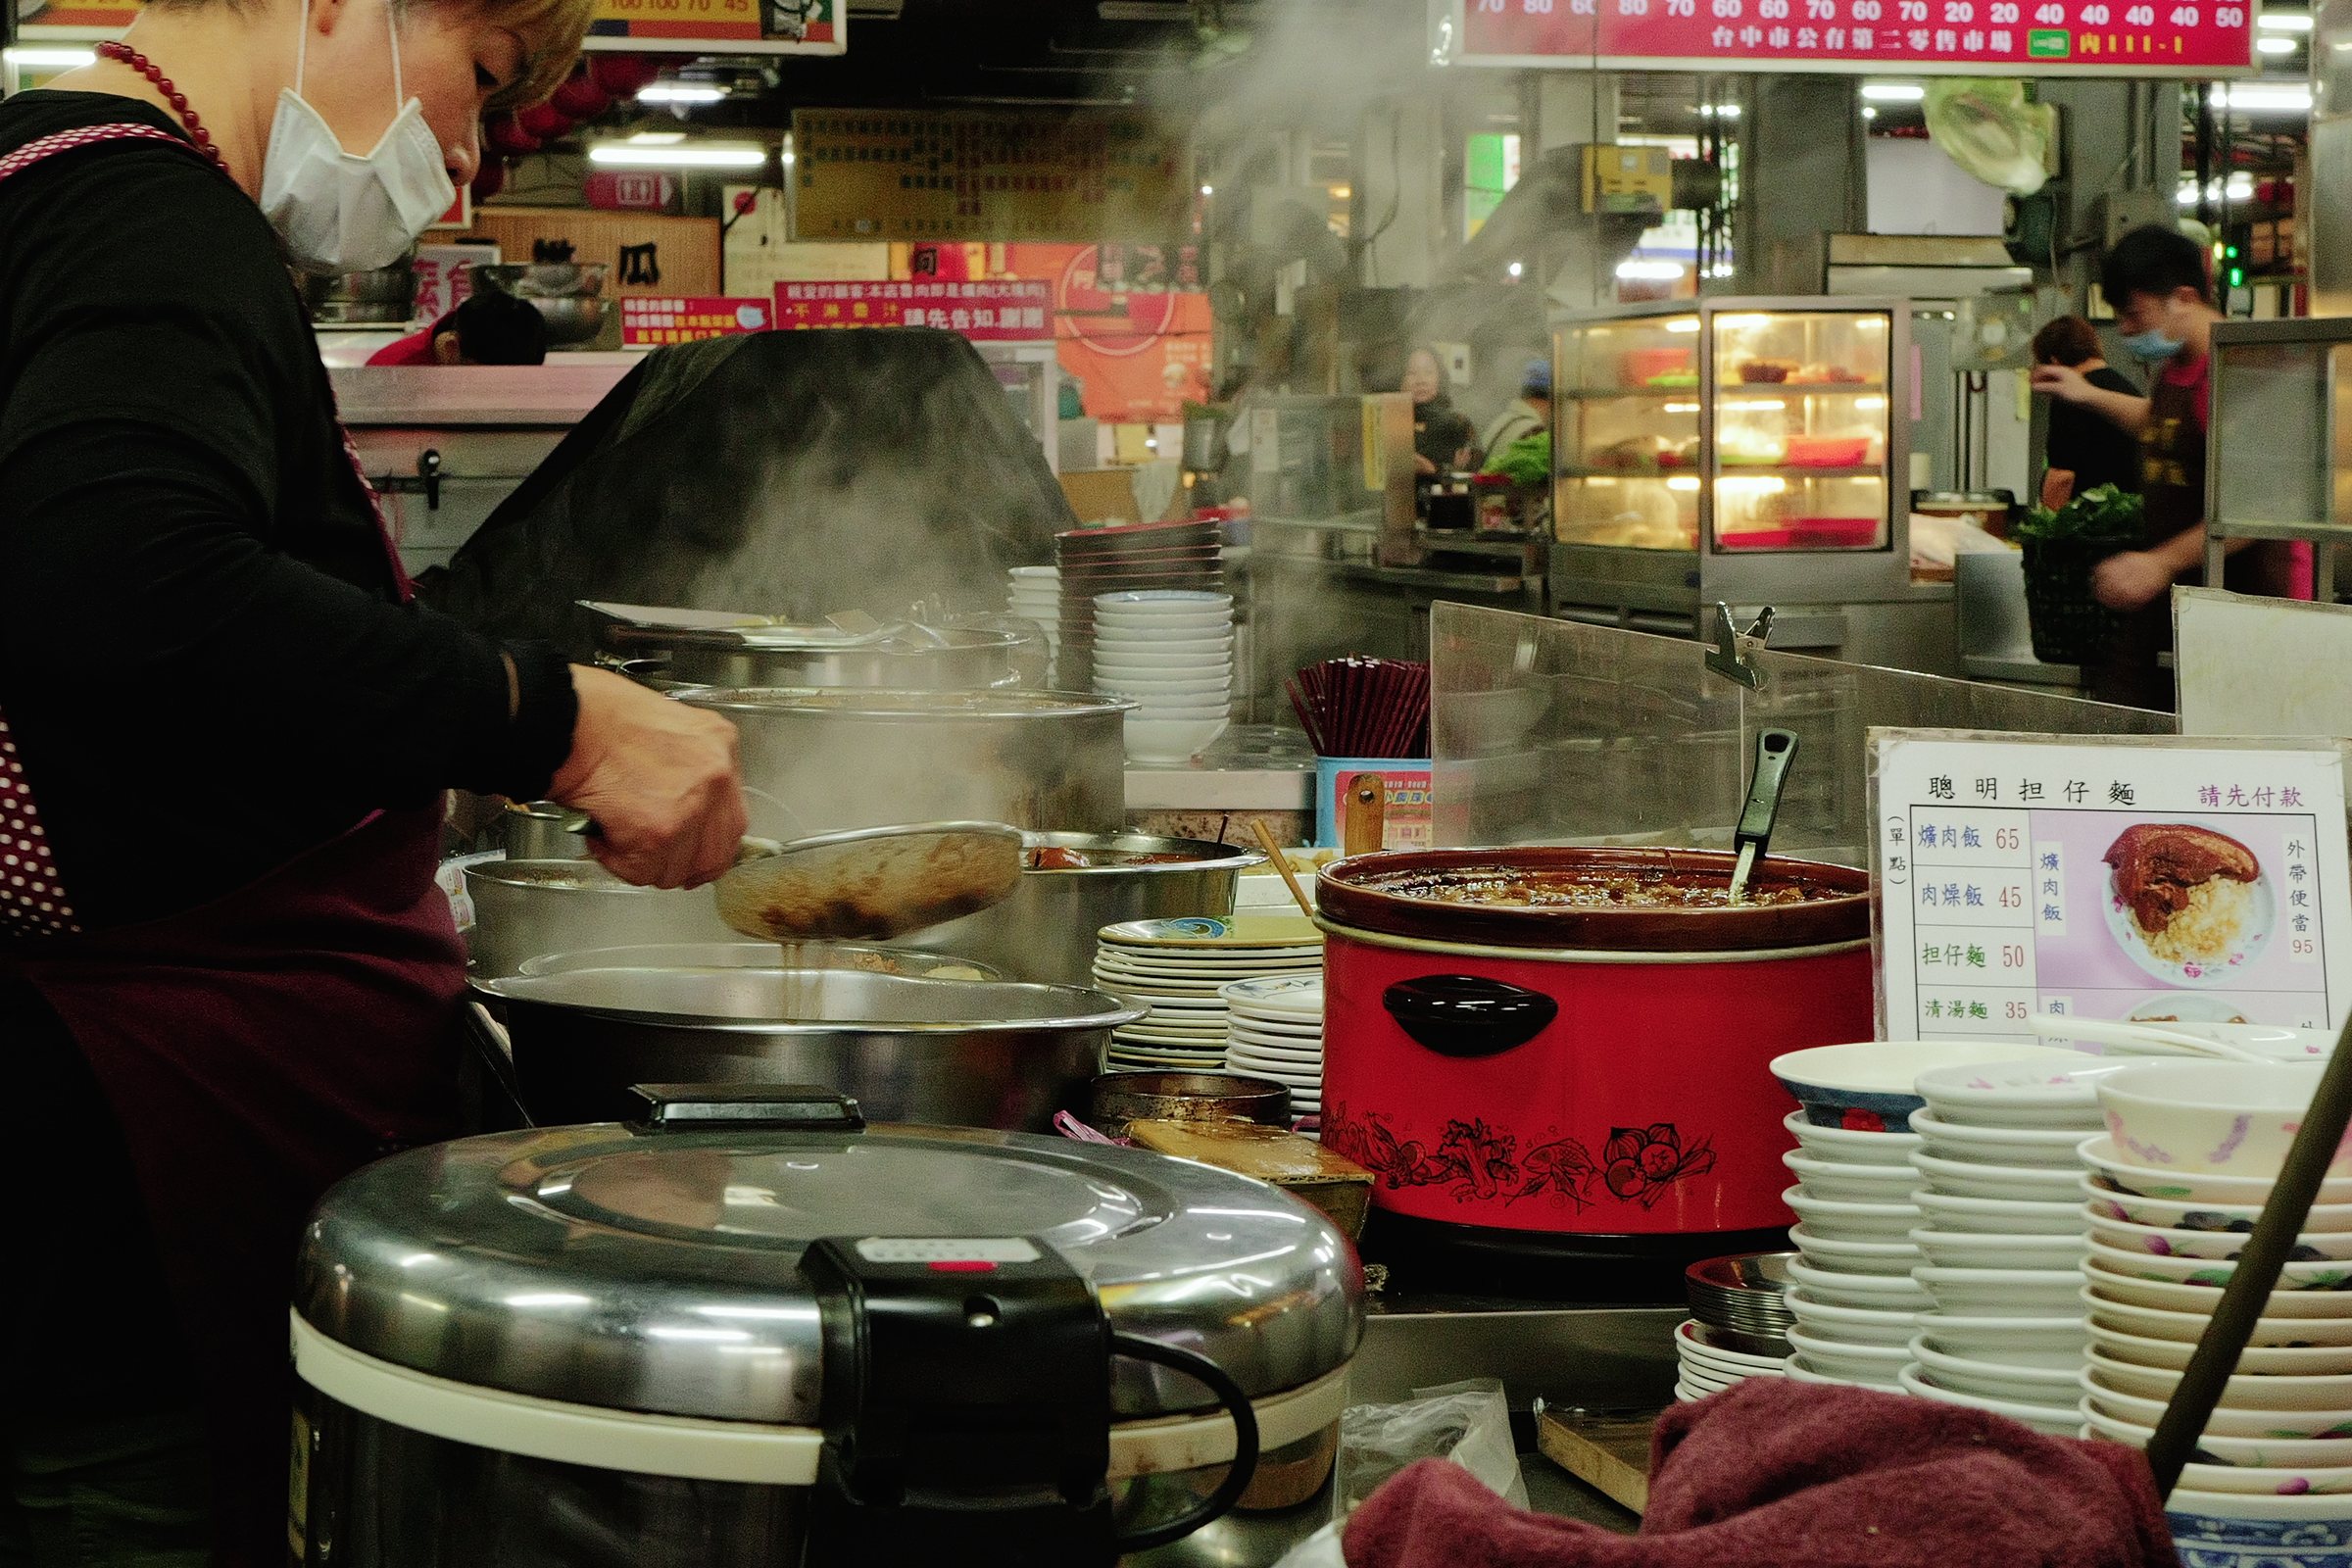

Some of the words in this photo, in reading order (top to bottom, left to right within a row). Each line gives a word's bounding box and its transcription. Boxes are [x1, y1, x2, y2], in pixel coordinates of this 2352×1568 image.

[1667, 0, 1694, 17] 70
[1712, 0, 1740, 18] 60
[1759, 0, 1788, 19] 60
[1806, 0, 1835, 20] 70
[1852, 2, 1881, 21] 60
[1898, 2, 1928, 22] 70
[1944, 2, 1973, 23] 20
[1990, 3, 2019, 24] 20
[2034, 4, 2064, 24] 40
[2080, 5, 2109, 25] 40
[2125, 6, 2154, 26] 40
[2170, 6, 2199, 27] 40
[2216, 7, 2243, 28] 50
[1711, 24, 2013, 54] 台中市公有第二零售市場
[1929, 774, 2135, 806] 聰明担仔麵
[2197, 784, 2305, 808] 請先付款
[1996, 827, 2020, 850] 65
[1922, 883, 1984, 906] 肉燥飯
[1999, 886, 2022, 907] 45
[2287, 840, 2310, 932] 外帶便當
[1922, 943, 1986, 968] 担仔麵
[2002, 945, 2025, 968] 50
[2292, 939, 2314, 955] 95
[1925, 999, 1988, 1020] 清湯麵
[2005, 1002, 2028, 1019] 35
